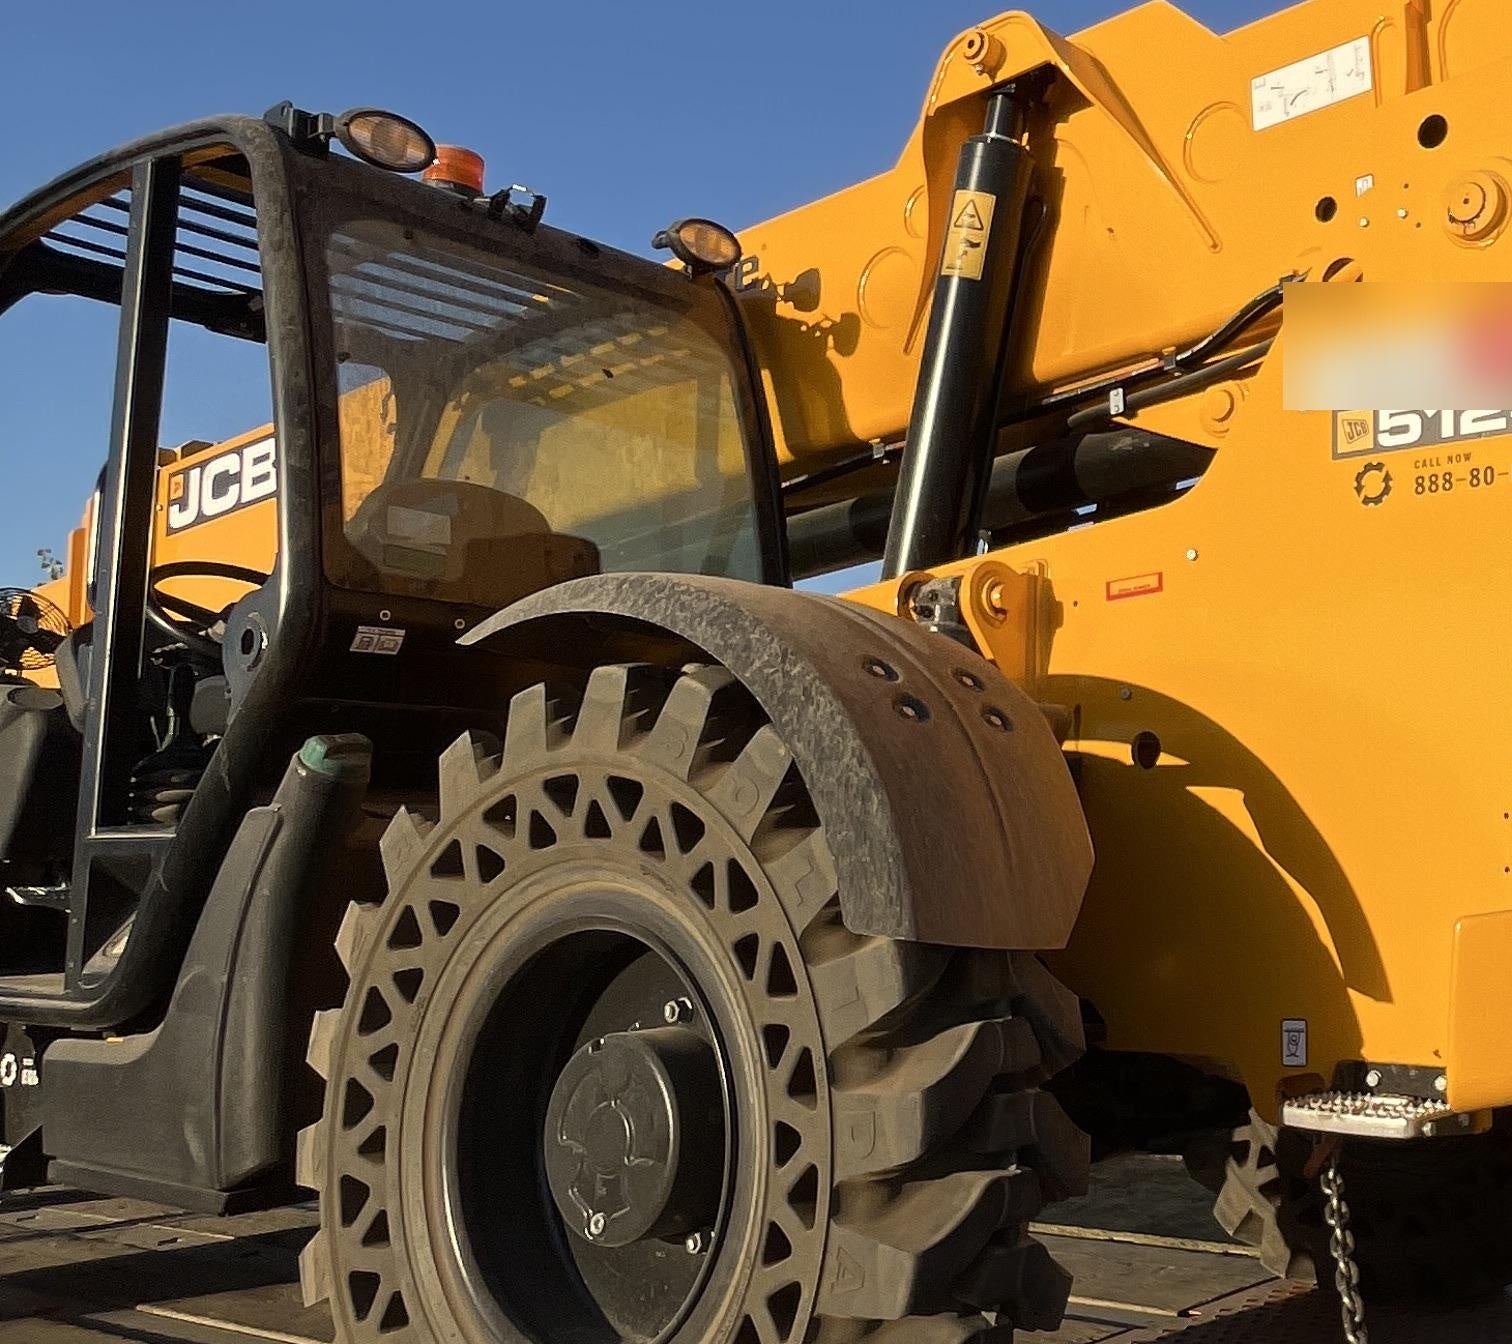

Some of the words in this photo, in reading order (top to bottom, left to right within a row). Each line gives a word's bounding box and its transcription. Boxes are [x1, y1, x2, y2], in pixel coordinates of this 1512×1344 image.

[1346, 420, 1368, 441] JCB
[1414, 456, 1441, 469] CALL
[1446, 451, 1473, 465] NOW
[169, 437, 278, 529] JCB
